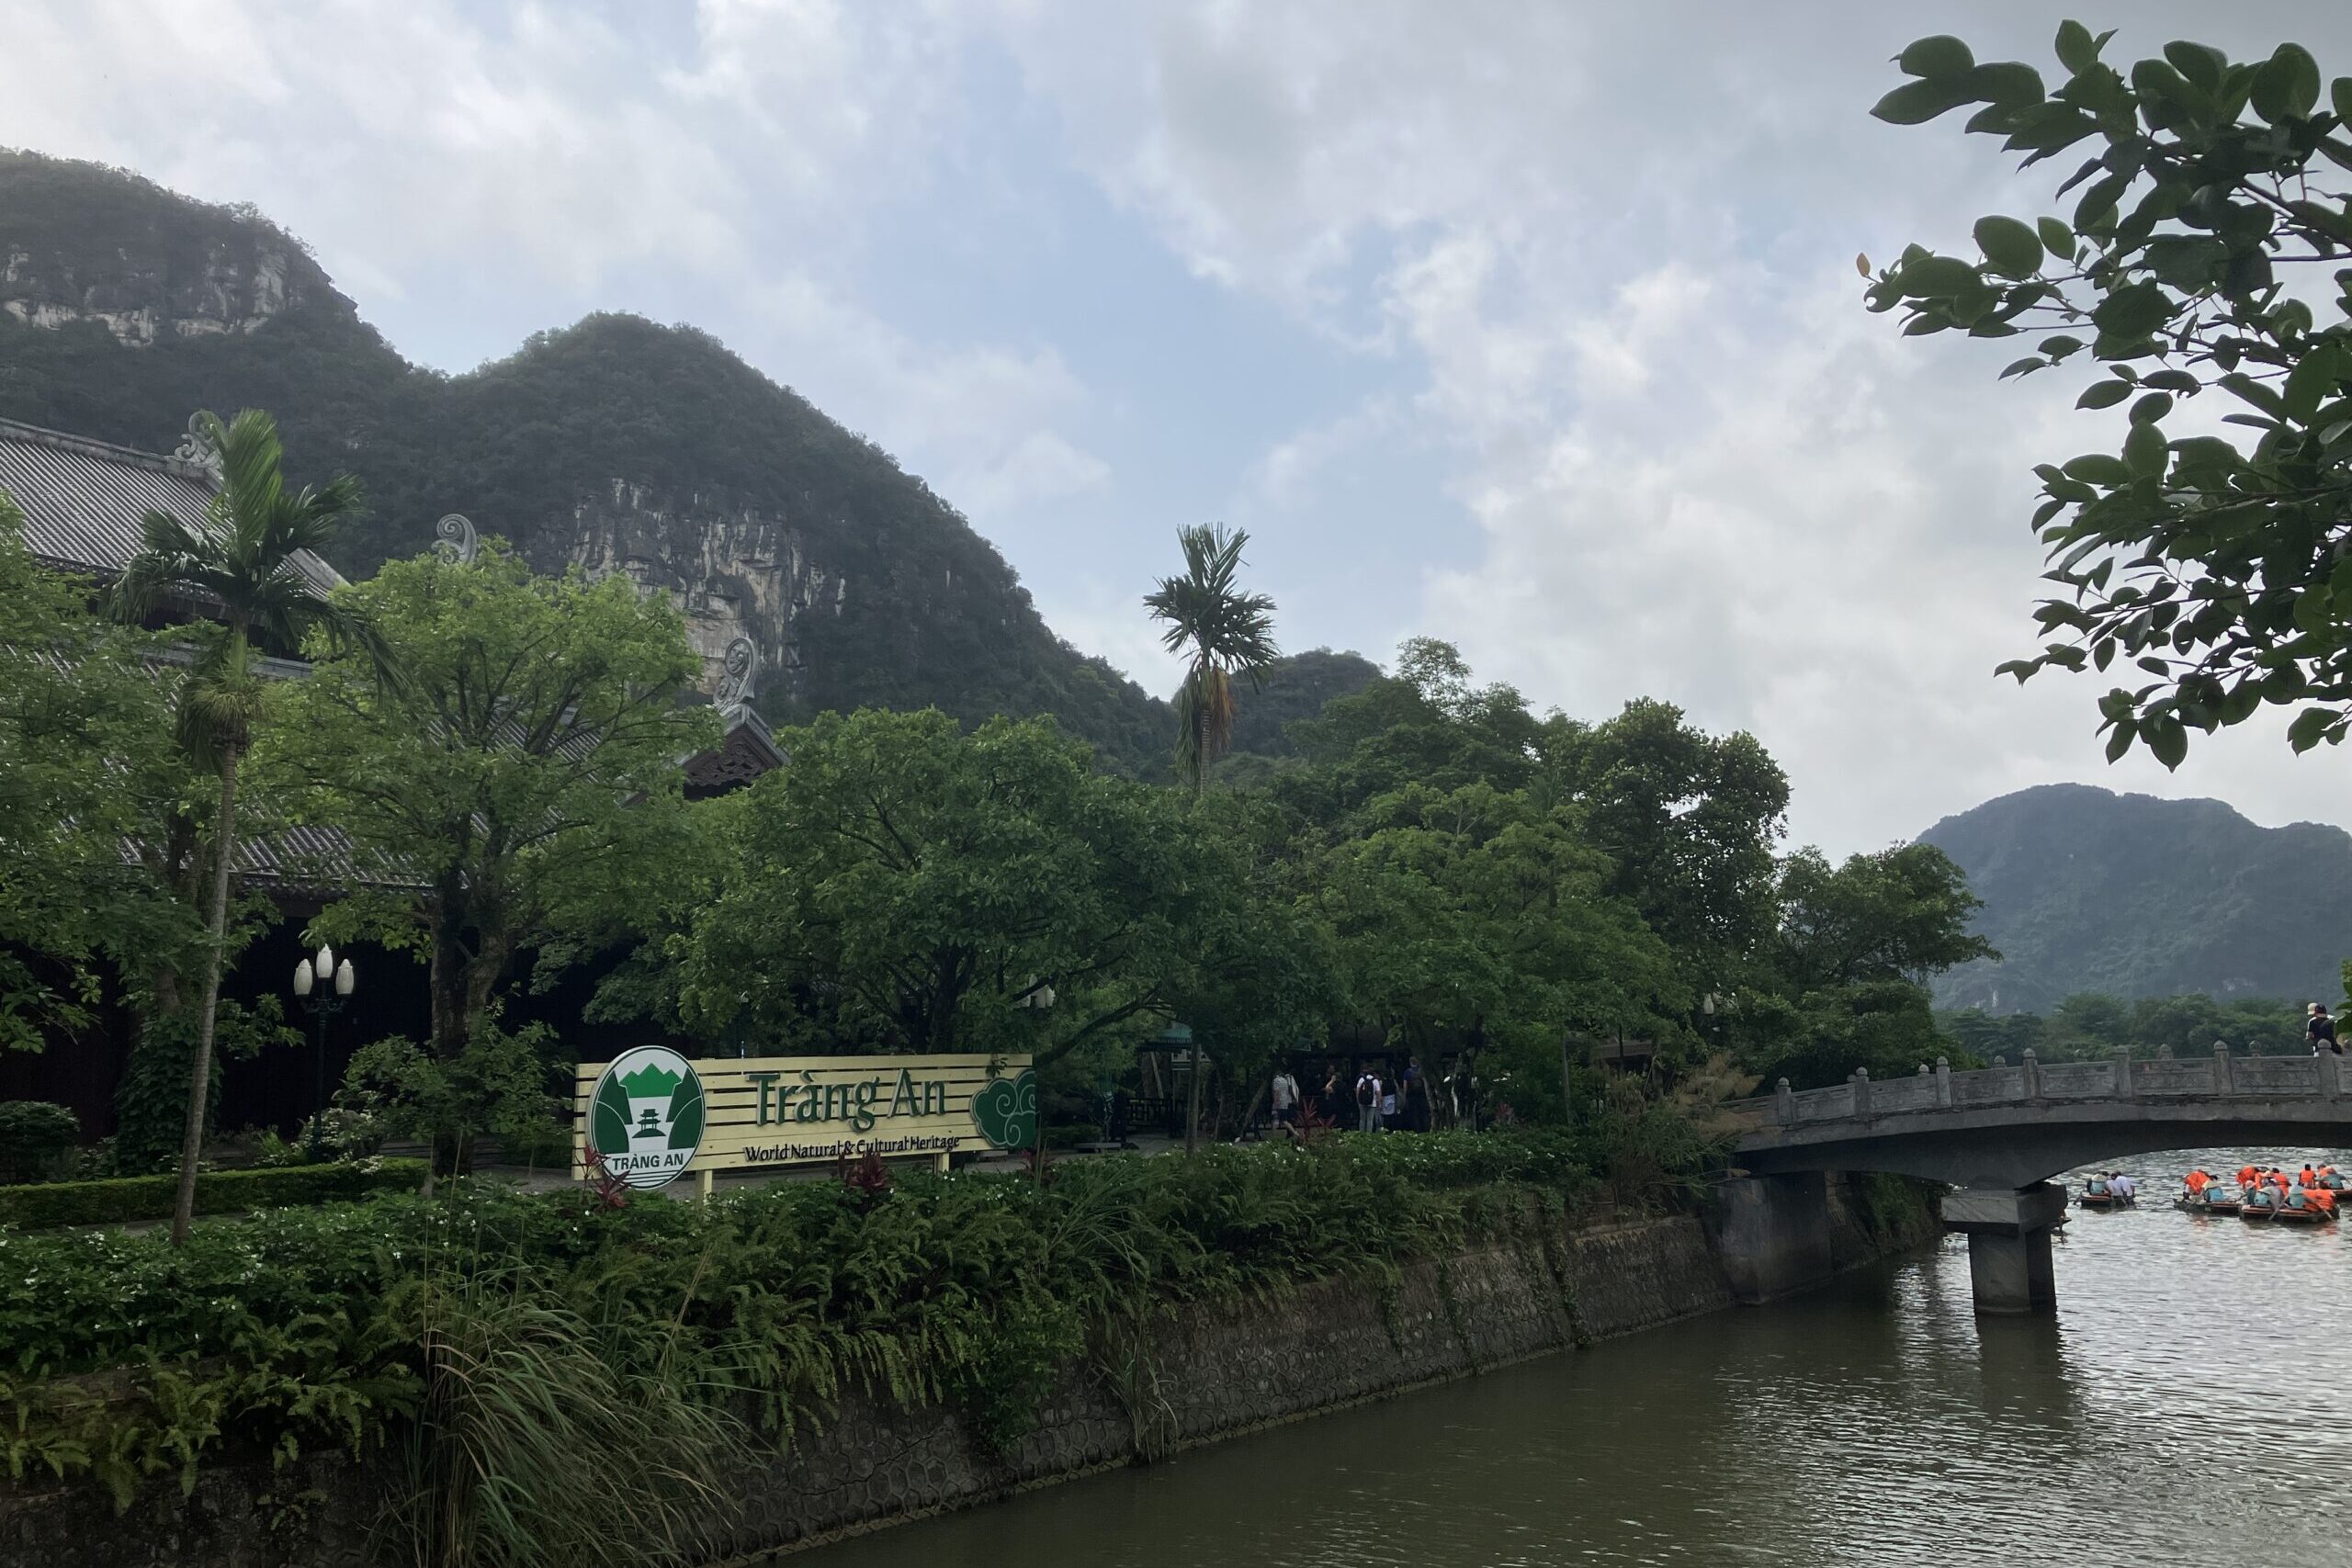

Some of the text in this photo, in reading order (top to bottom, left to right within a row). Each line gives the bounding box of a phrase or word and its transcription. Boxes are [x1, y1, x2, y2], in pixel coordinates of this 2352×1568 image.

[746, 1067, 945, 1133] Tràng An
[612, 1153, 684, 1170] TRÀNG AN
[744, 1134, 960, 1162] World Natural & Cultural Heritage
